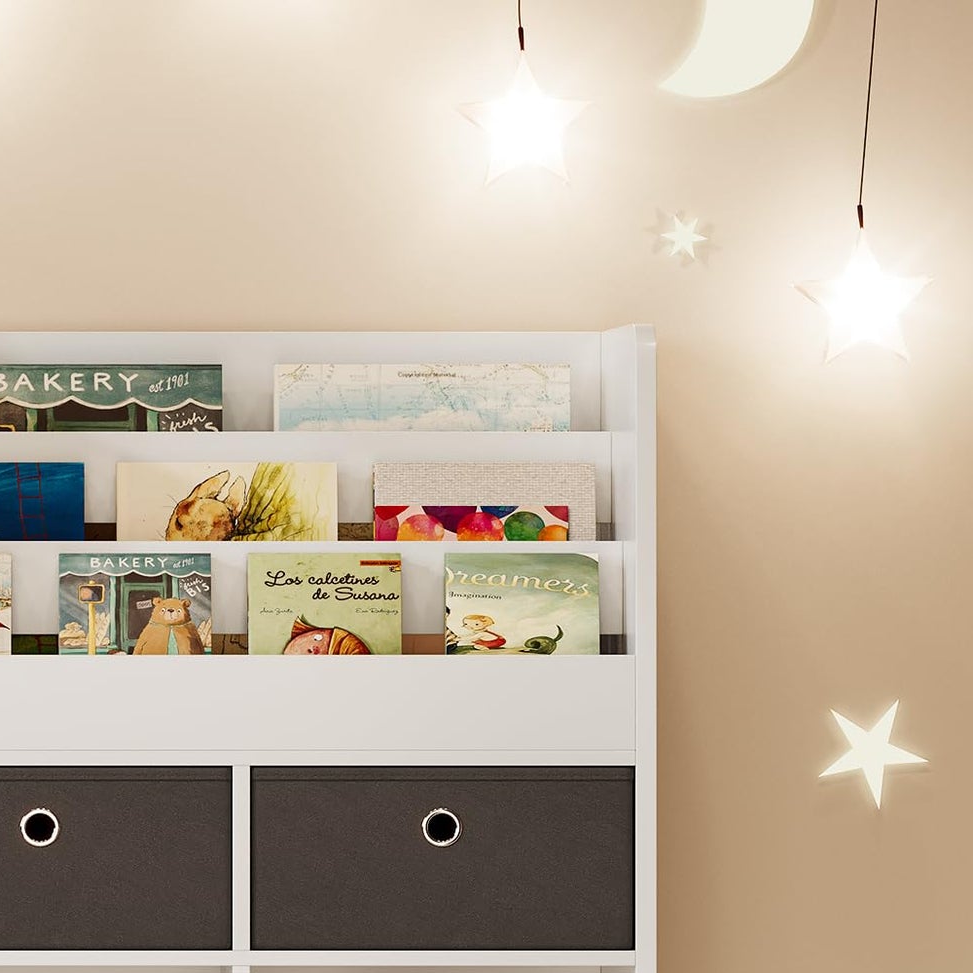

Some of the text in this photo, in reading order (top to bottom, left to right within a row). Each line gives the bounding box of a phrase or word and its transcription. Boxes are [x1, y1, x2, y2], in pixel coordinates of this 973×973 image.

[148, 380, 164, 393] est
[165, 372, 190, 391] 1901
[90, 557, 167, 568] BAKERY
[264, 570, 380, 588] Los calcetines
[311, 586, 400, 601] de Susana
[448, 590, 503, 600] Imagination
